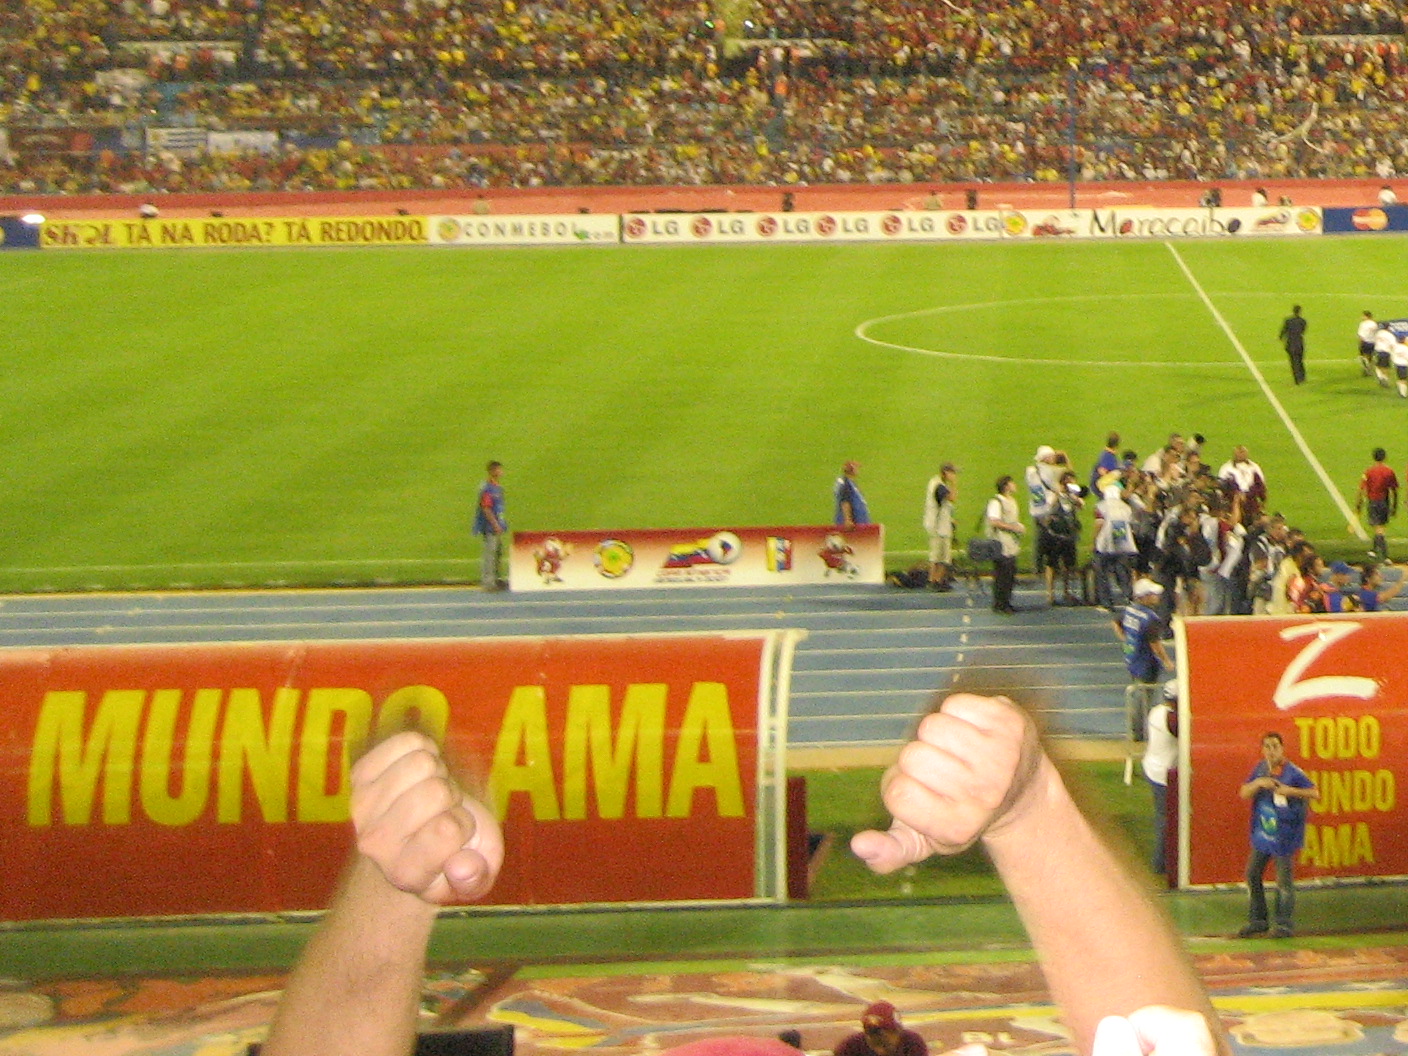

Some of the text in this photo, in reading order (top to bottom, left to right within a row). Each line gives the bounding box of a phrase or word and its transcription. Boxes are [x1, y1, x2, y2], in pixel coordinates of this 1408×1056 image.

[161, 223, 194, 244] NA
[204, 222, 274, 243] RODA?
[652, 220, 679, 235] LG
[718, 219, 745, 234] LG
[783, 219, 810, 234] LG
[842, 218, 869, 234] LG
[907, 218, 934, 233] LG
[488, 681, 746, 820] AMA
[1294, 714, 1382, 760] TODO
[1308, 769, 1395, 815] UNDO
[1300, 821, 1376, 868] AMA
